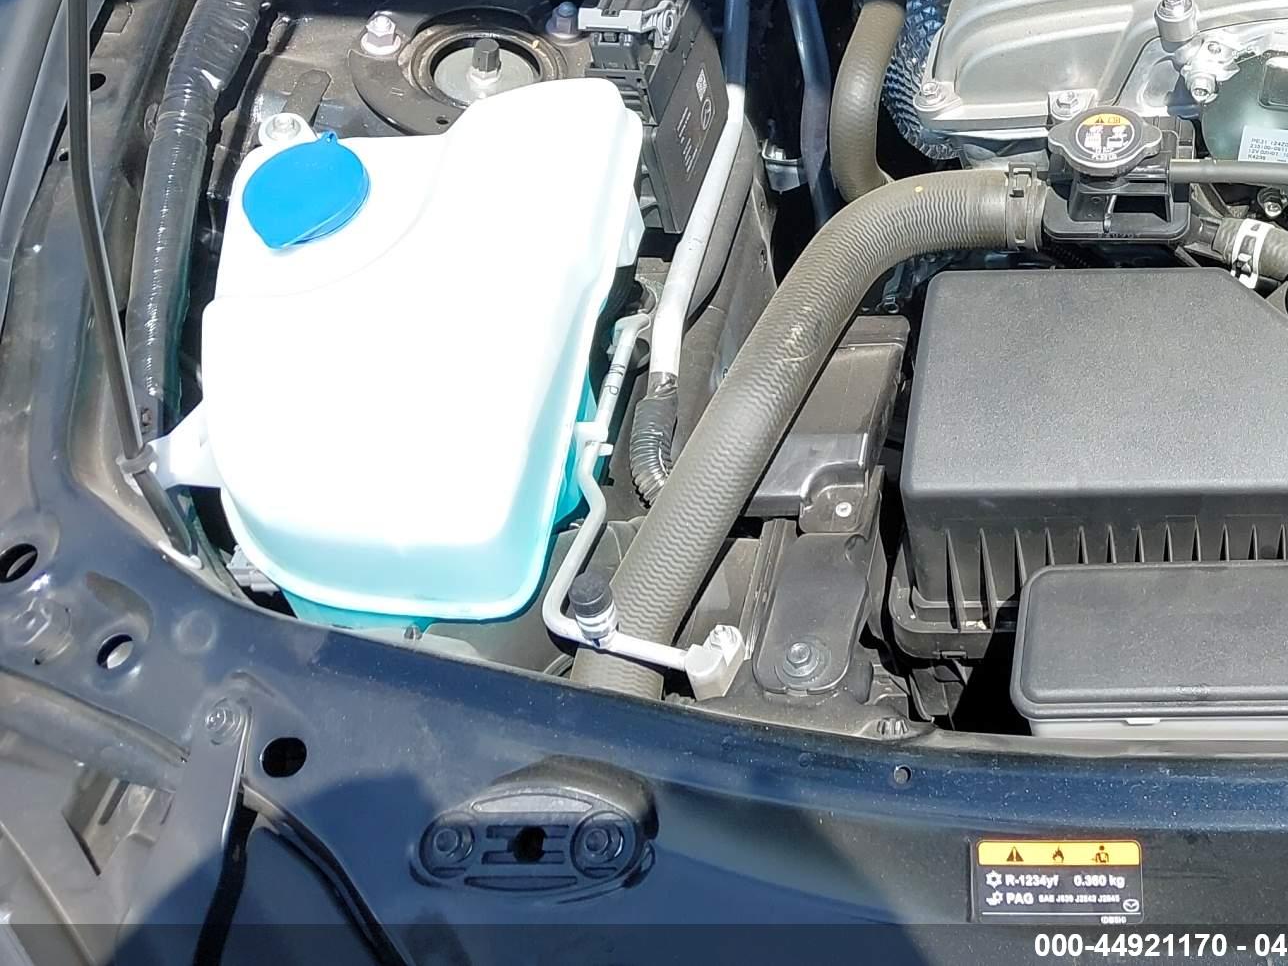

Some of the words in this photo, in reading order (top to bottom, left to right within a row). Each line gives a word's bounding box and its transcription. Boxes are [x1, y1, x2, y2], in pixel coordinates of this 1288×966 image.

[1004, 874, 1060, 889] R-1234yf
[1109, 874, 1125, 889] kg
[1006, 892, 1034, 905] PAG
